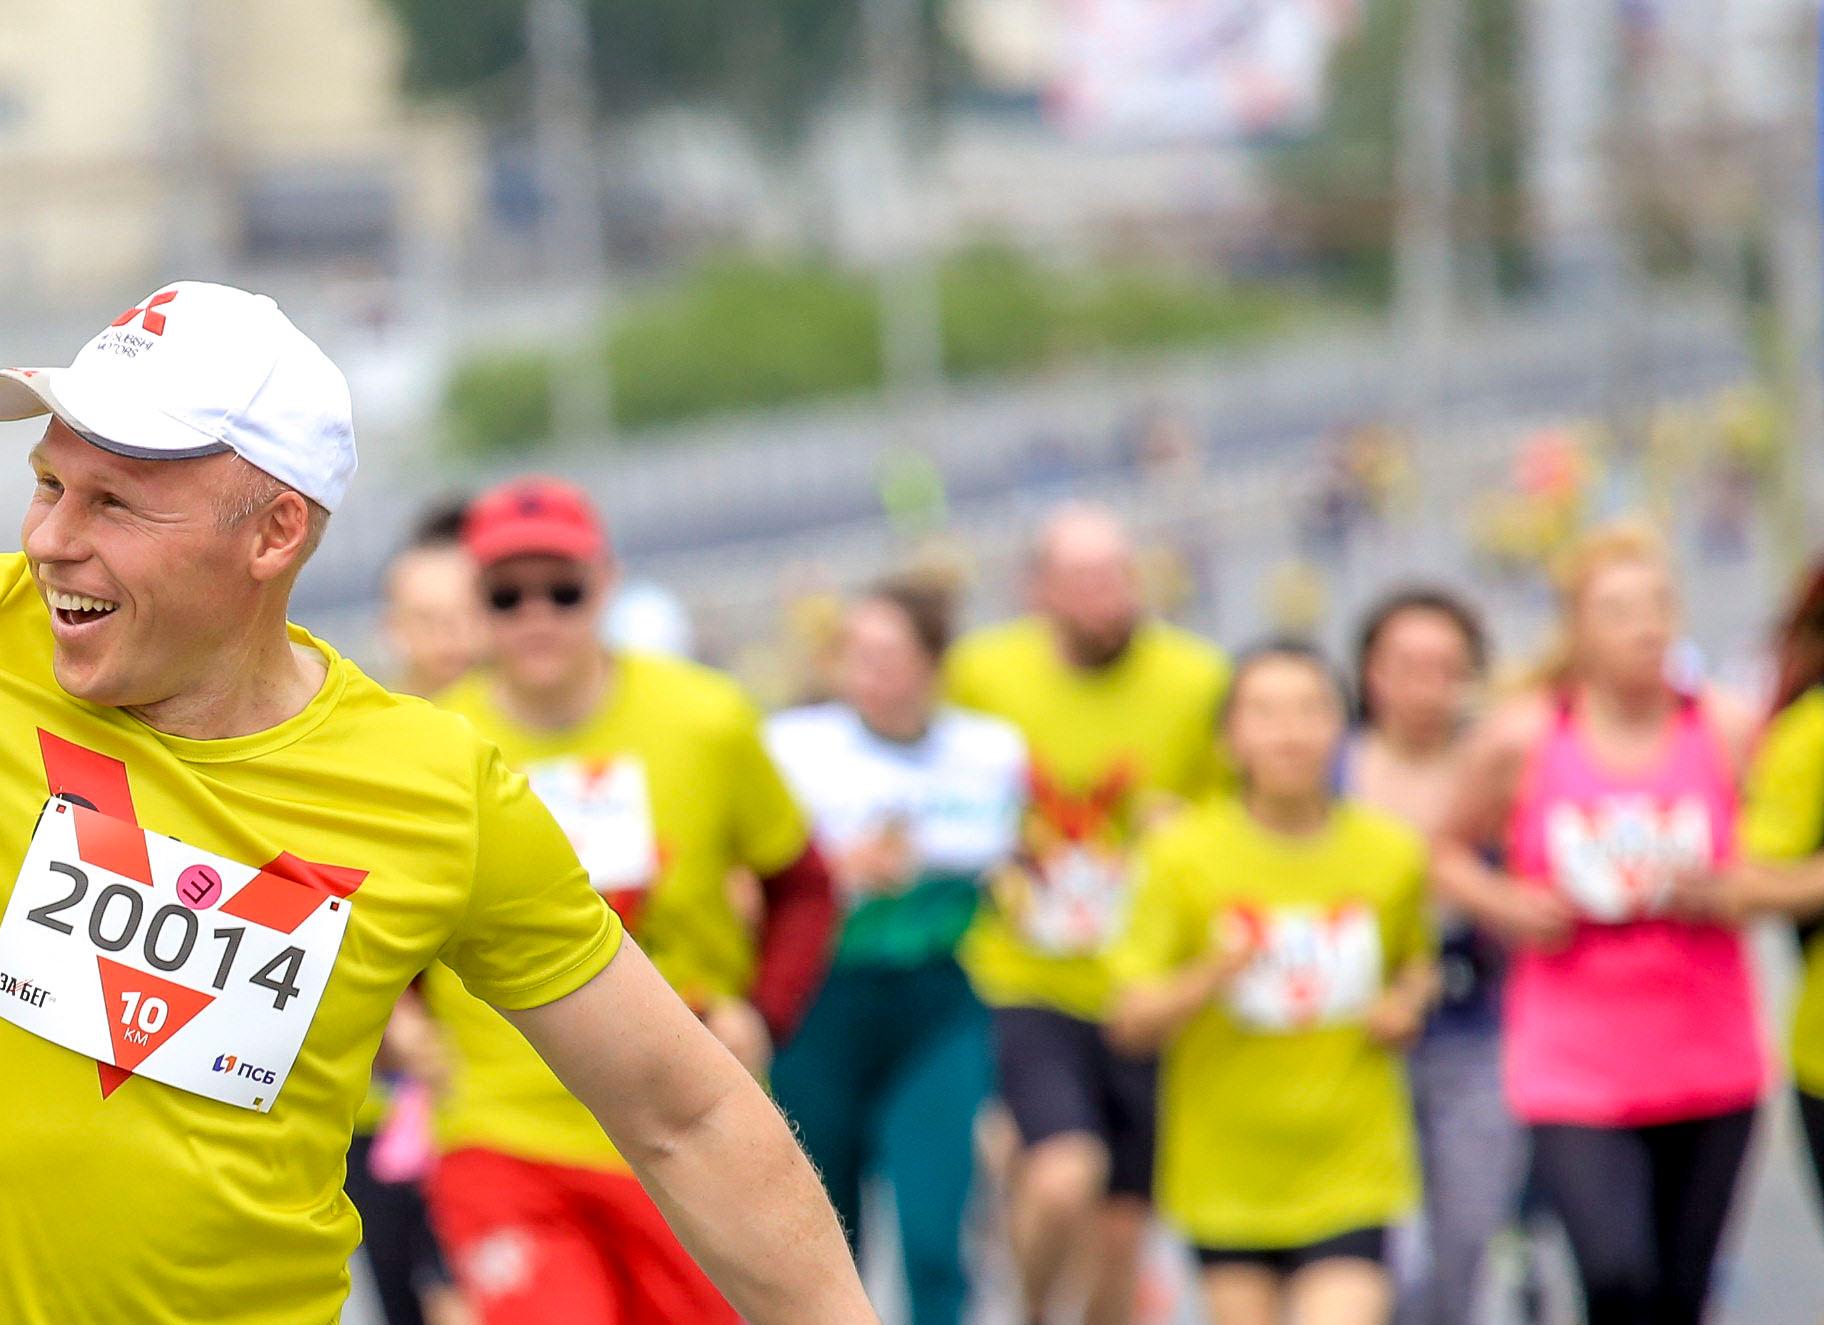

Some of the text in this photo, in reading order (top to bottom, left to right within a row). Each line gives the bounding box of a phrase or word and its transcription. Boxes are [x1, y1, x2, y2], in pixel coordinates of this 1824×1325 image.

[26, 861, 306, 1011] 20014
[120, 991, 169, 1034] 10
[237, 1062, 276, 1085] ПСБ
